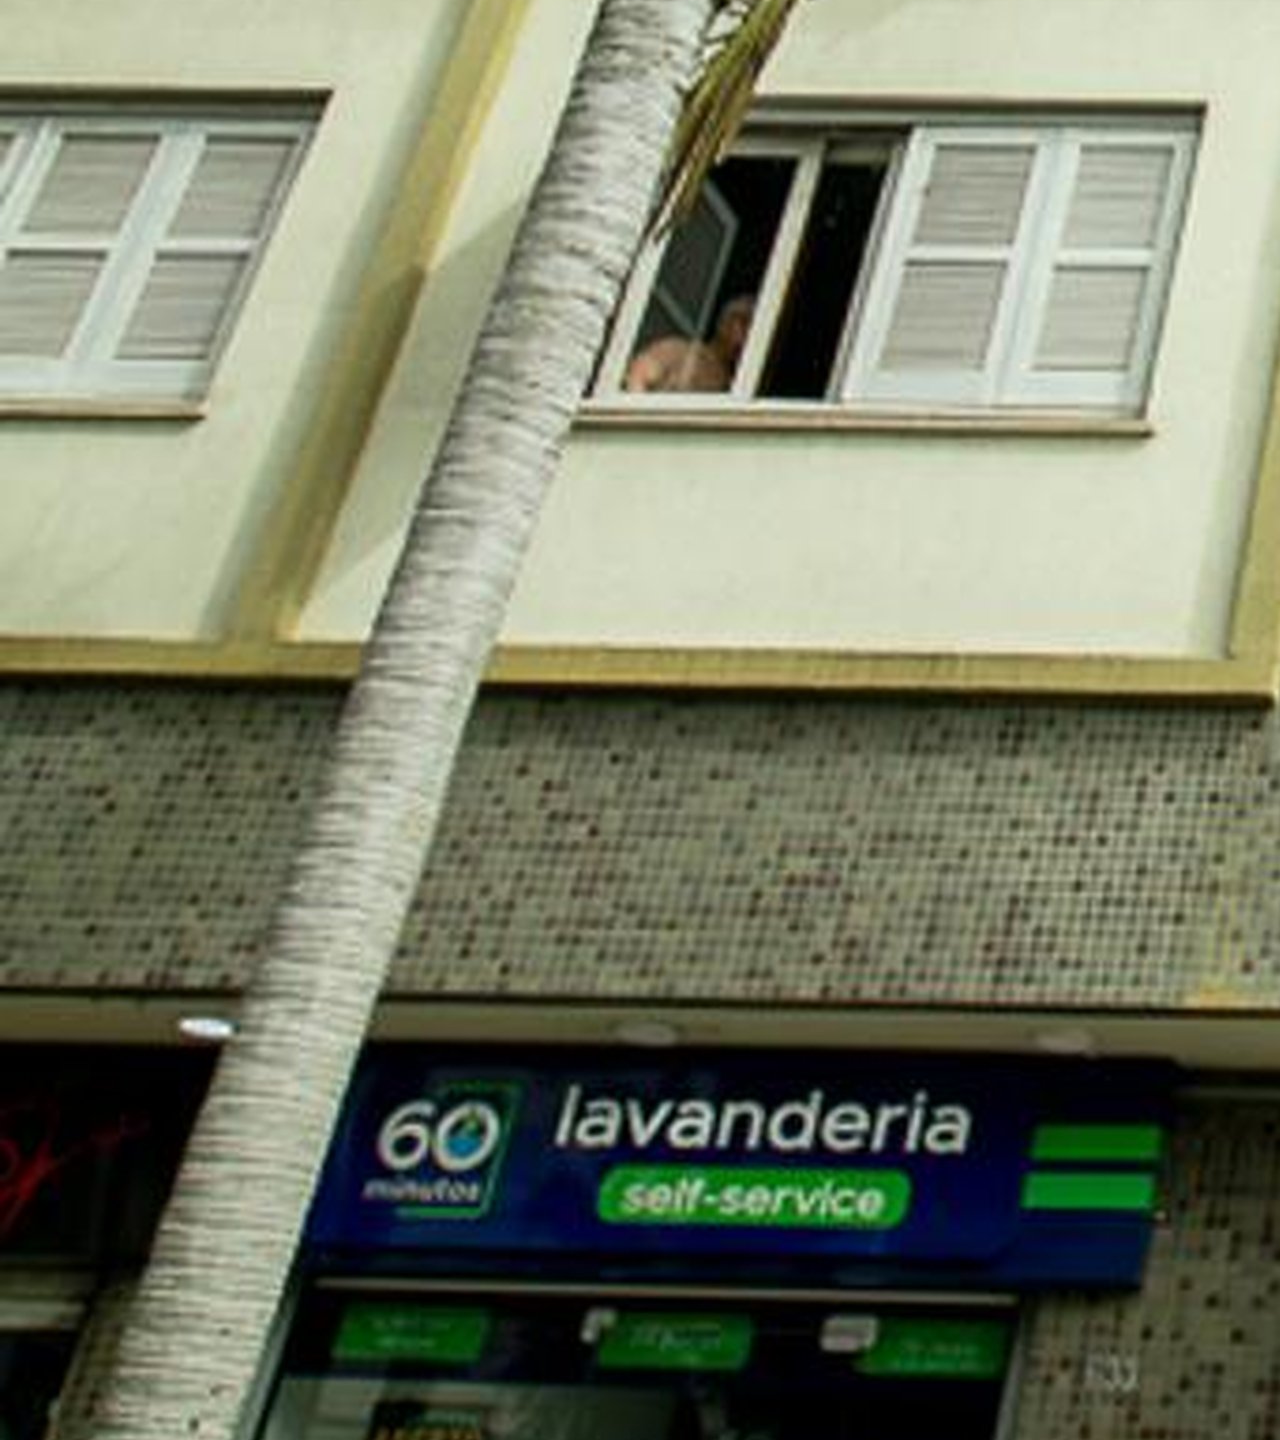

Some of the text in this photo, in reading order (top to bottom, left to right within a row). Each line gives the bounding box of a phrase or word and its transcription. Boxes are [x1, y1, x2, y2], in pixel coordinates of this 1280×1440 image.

[377, 1100, 500, 1171] 60
[554, 1083, 973, 1153] lavanderia
[618, 1176, 886, 1219] self-service
